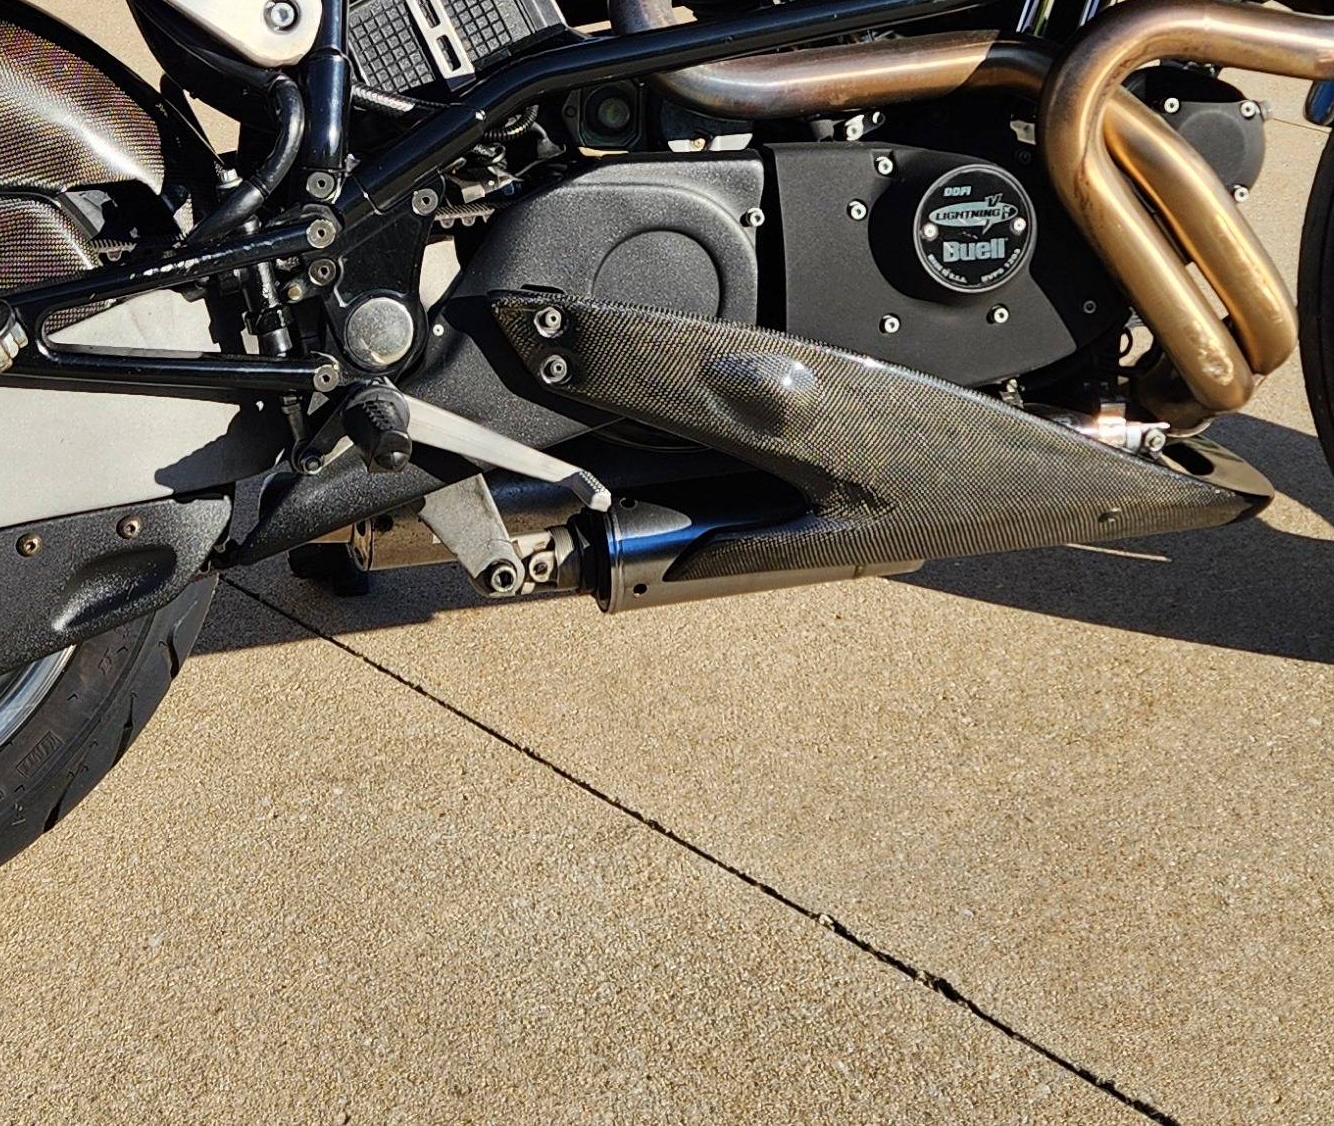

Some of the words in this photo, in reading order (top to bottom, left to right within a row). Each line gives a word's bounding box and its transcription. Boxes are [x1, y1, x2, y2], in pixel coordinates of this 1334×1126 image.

[943, 186, 972, 197] DDFI
[935, 208, 1001, 221] LIGHTNING
[943, 237, 1006, 263] Buell
